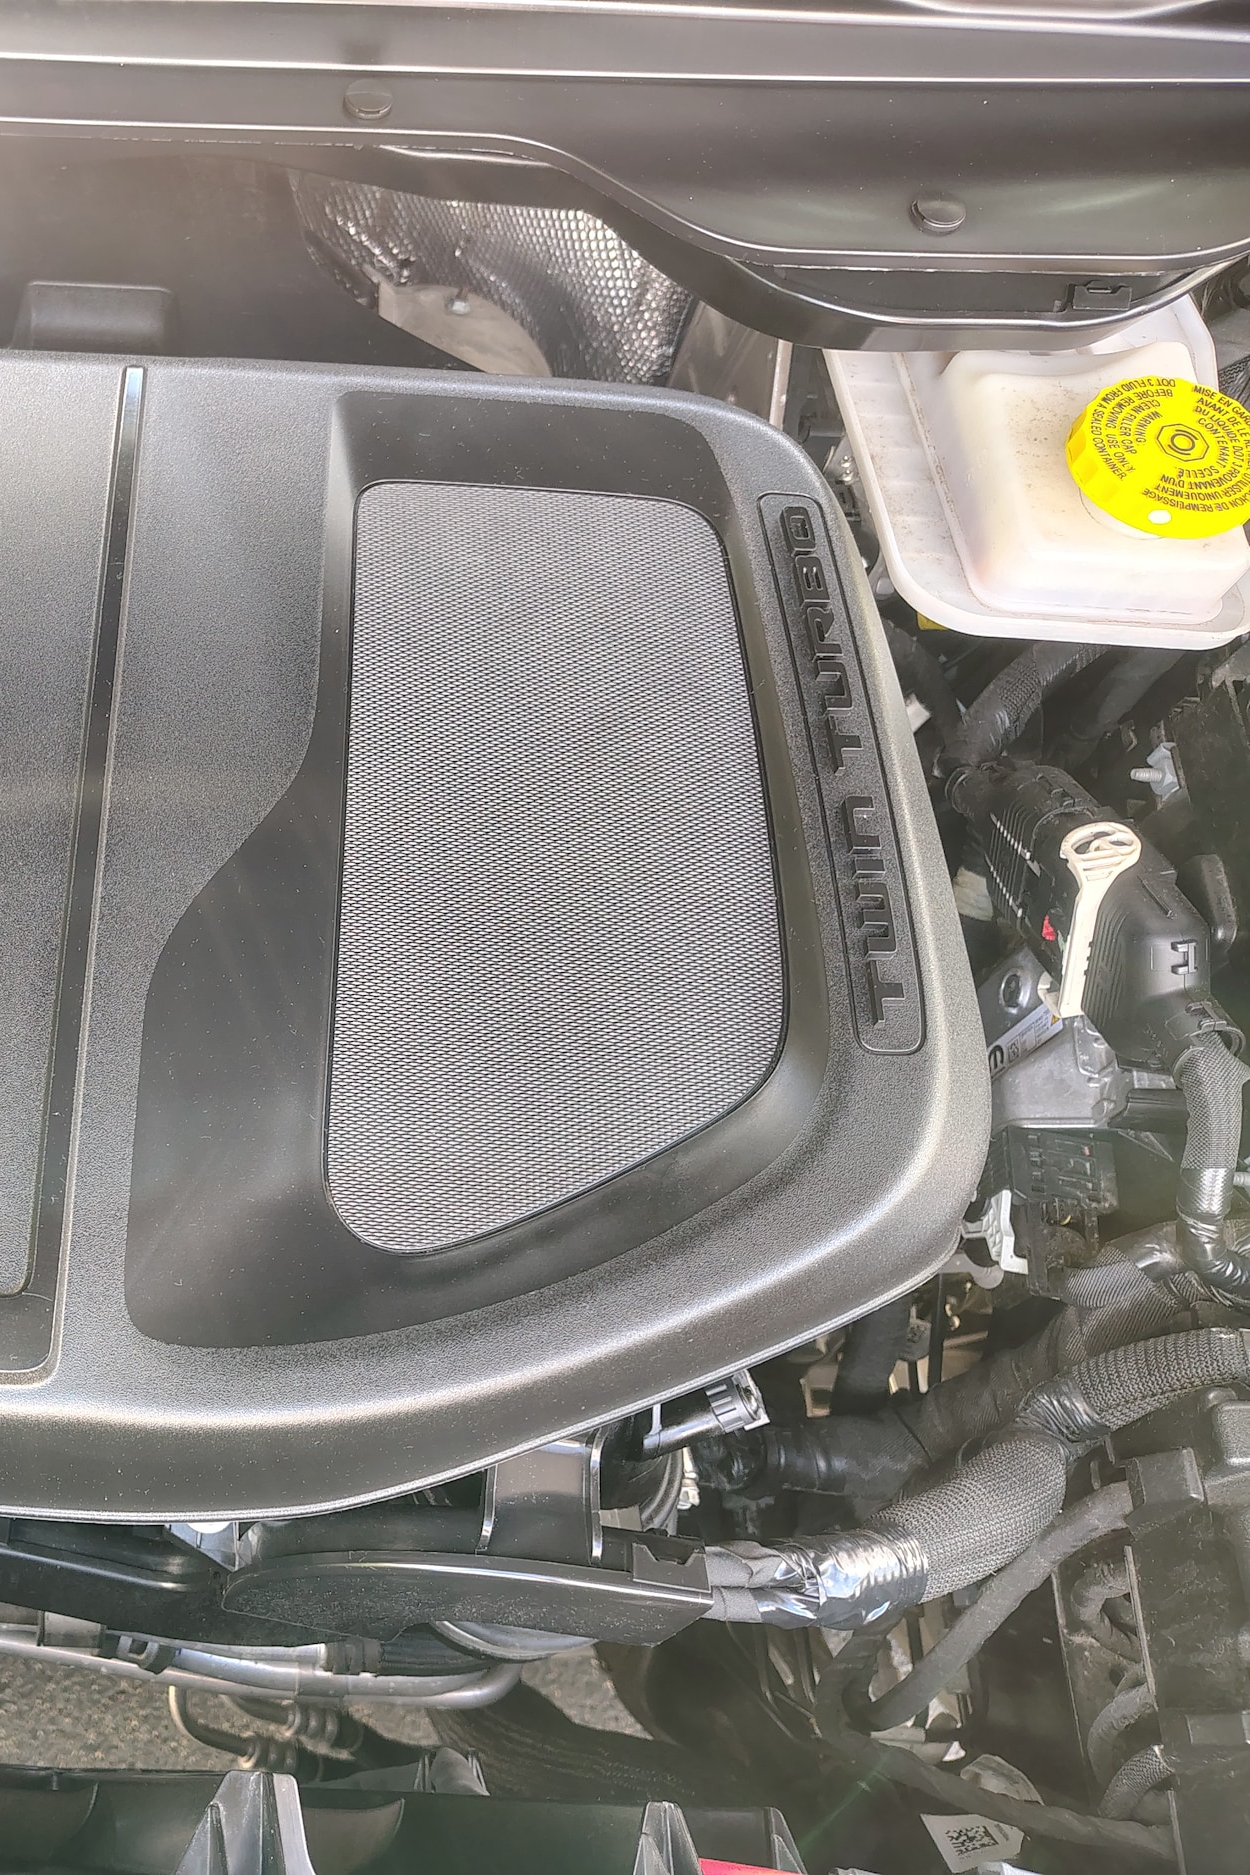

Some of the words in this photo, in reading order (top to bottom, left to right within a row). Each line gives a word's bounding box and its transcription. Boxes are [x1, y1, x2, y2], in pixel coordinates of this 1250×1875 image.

[1123, 379, 1147, 392] FLUID
[1149, 379, 1154, 387] 3
[1157, 379, 1176, 387] DOT
[1102, 386, 1123, 404] FROM
[1135, 388, 1173, 400] BEFORE
[1194, 386, 1217, 399] MISE
[1218, 396, 1232, 407] EN
[1135, 399, 1161, 413] CLEAN
[1194, 406, 1210, 417] DU
[1090, 409, 1104, 436] SEALED
[1119, 412, 1137, 437] FILLER
[1197, 398, 1228, 416] AVANT
[1228, 416, 1241, 428] DE
[1237, 427, 1249, 438] LE
[1209, 413, 1240, 443] LIQUIDE
[1106, 434, 1120, 449] USE
[1121, 437, 1137, 454] CAP
[1197, 418, 1230, 468] CONTENANT
[1114, 449, 1136, 473] ONLY
[1233, 445, 1244, 462] DOT
[1161, 475, 1185, 488] D'UN
[1189, 468, 1240, 490] PROVENANT
[1142, 488, 1213, 512] REMPLISSAGE
[1155, 484, 1224, 501] UNIQUEMENT
[1215, 500, 1230, 511] DE
[778, 505, 865, 776] TURBO
[840, 794, 906, 1028] TWIN
